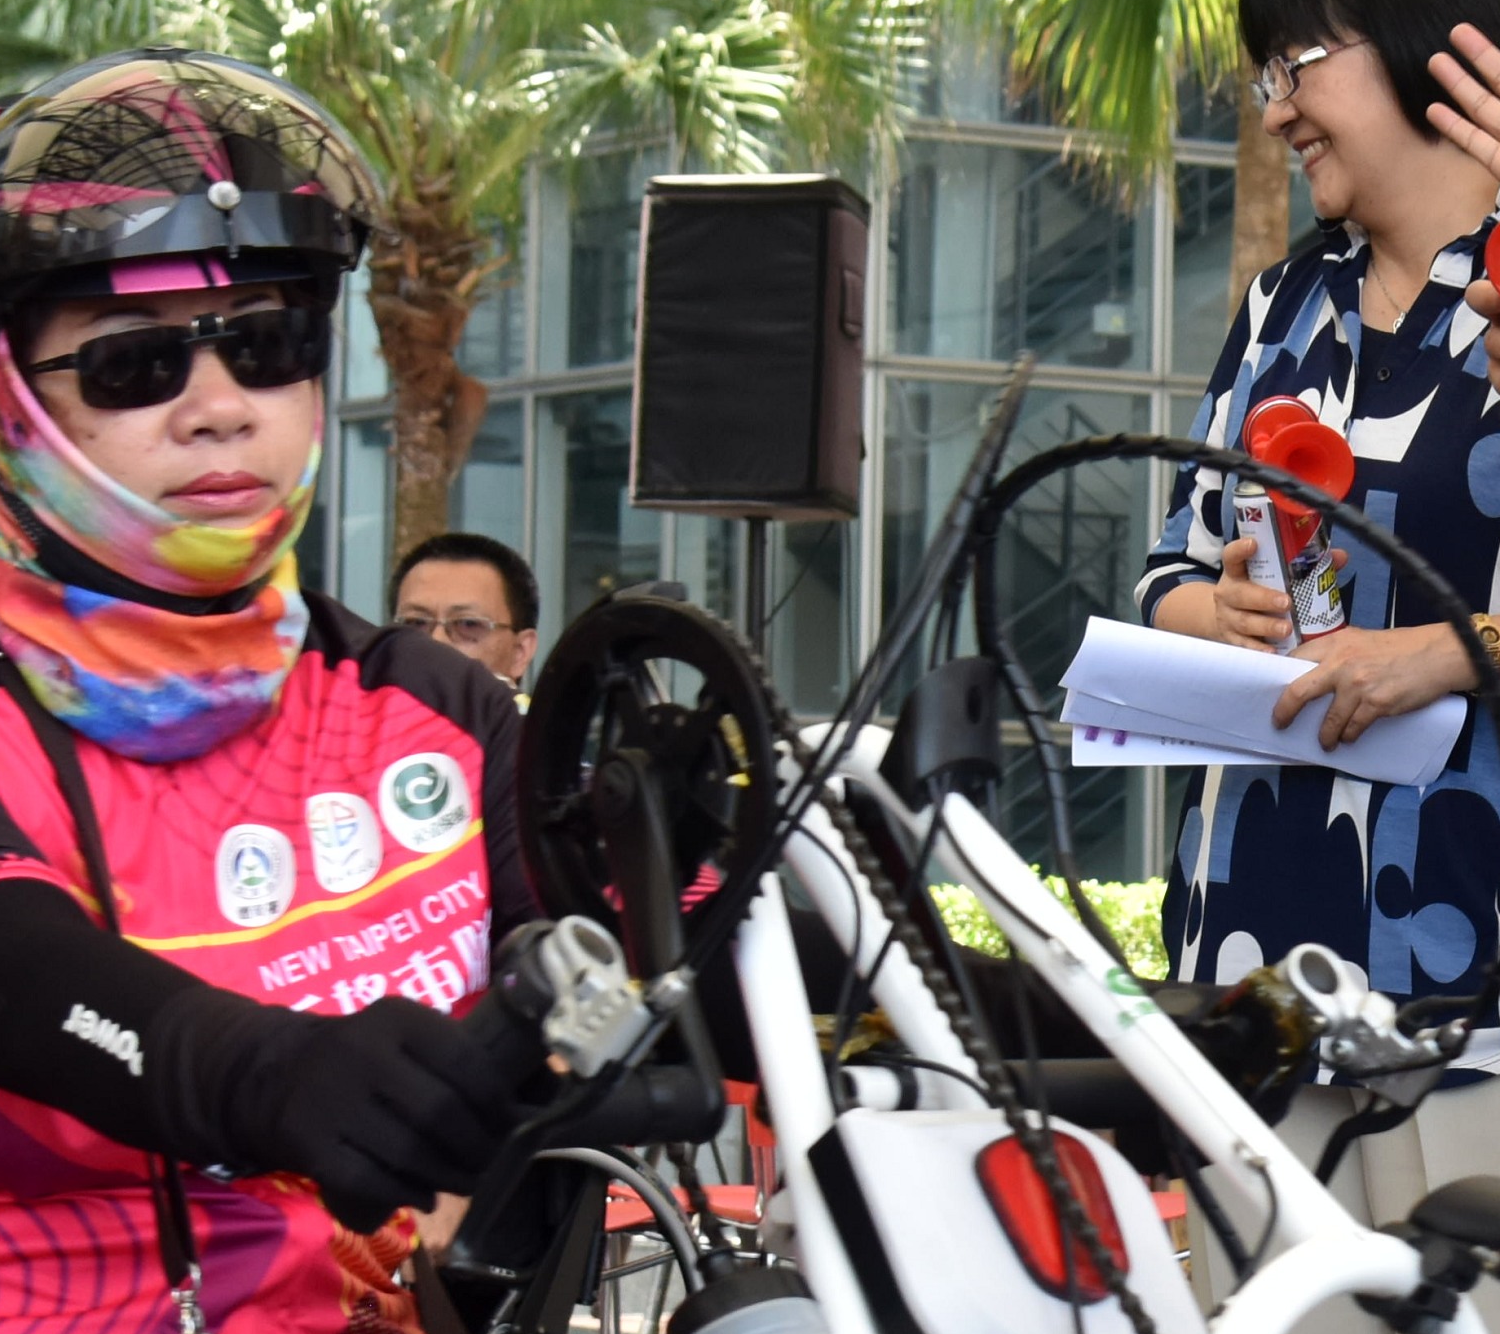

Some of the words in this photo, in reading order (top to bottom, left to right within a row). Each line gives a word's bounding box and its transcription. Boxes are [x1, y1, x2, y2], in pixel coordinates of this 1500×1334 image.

[257, 941, 331, 992] NEW
[332, 908, 422, 962] TAIPEI
[420, 869, 487, 925] CITY
